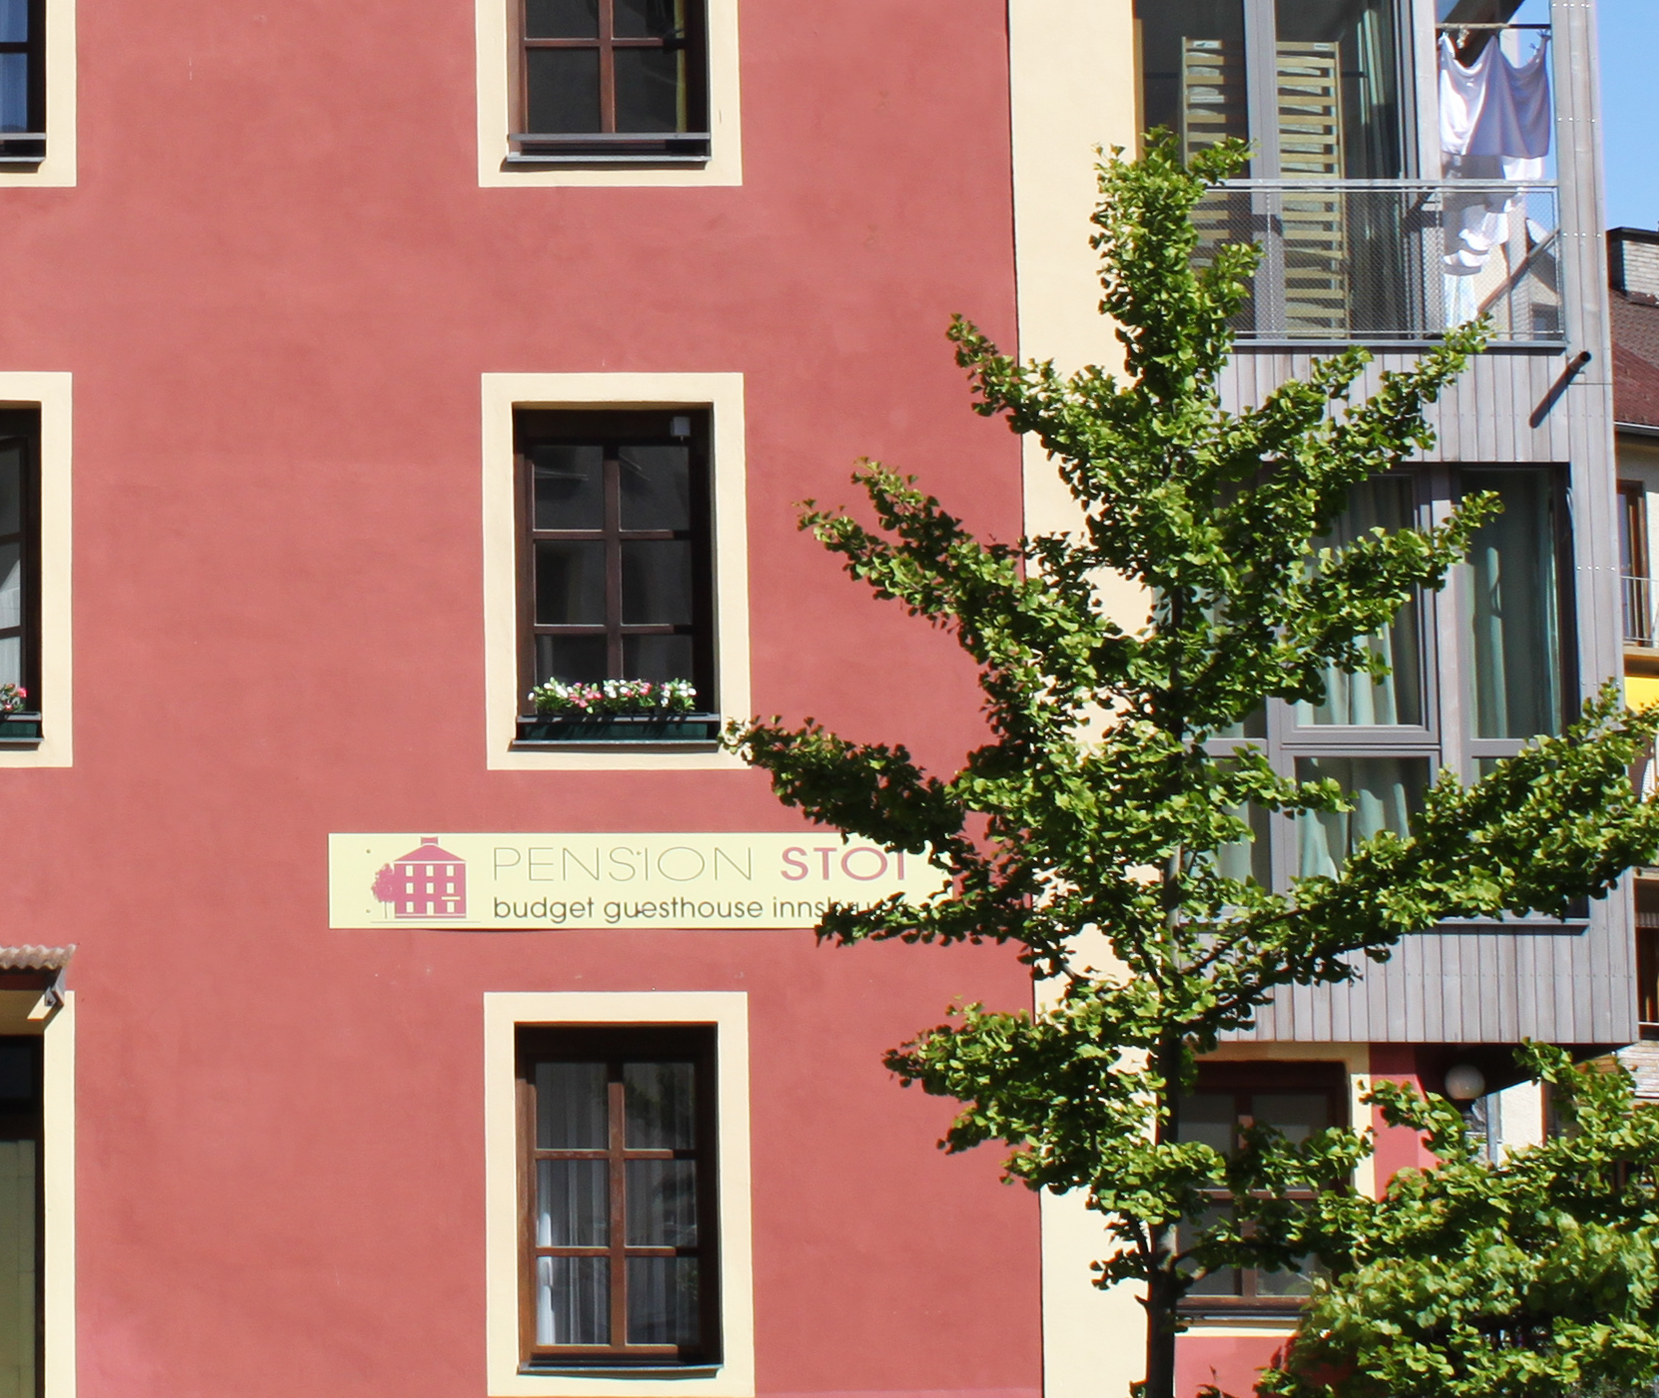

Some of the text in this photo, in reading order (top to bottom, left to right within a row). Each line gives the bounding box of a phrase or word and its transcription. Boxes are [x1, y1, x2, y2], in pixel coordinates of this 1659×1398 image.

[493, 846, 753, 882] PENSION
[493, 896, 595, 924] budget
[603, 896, 764, 924] guesthouse
